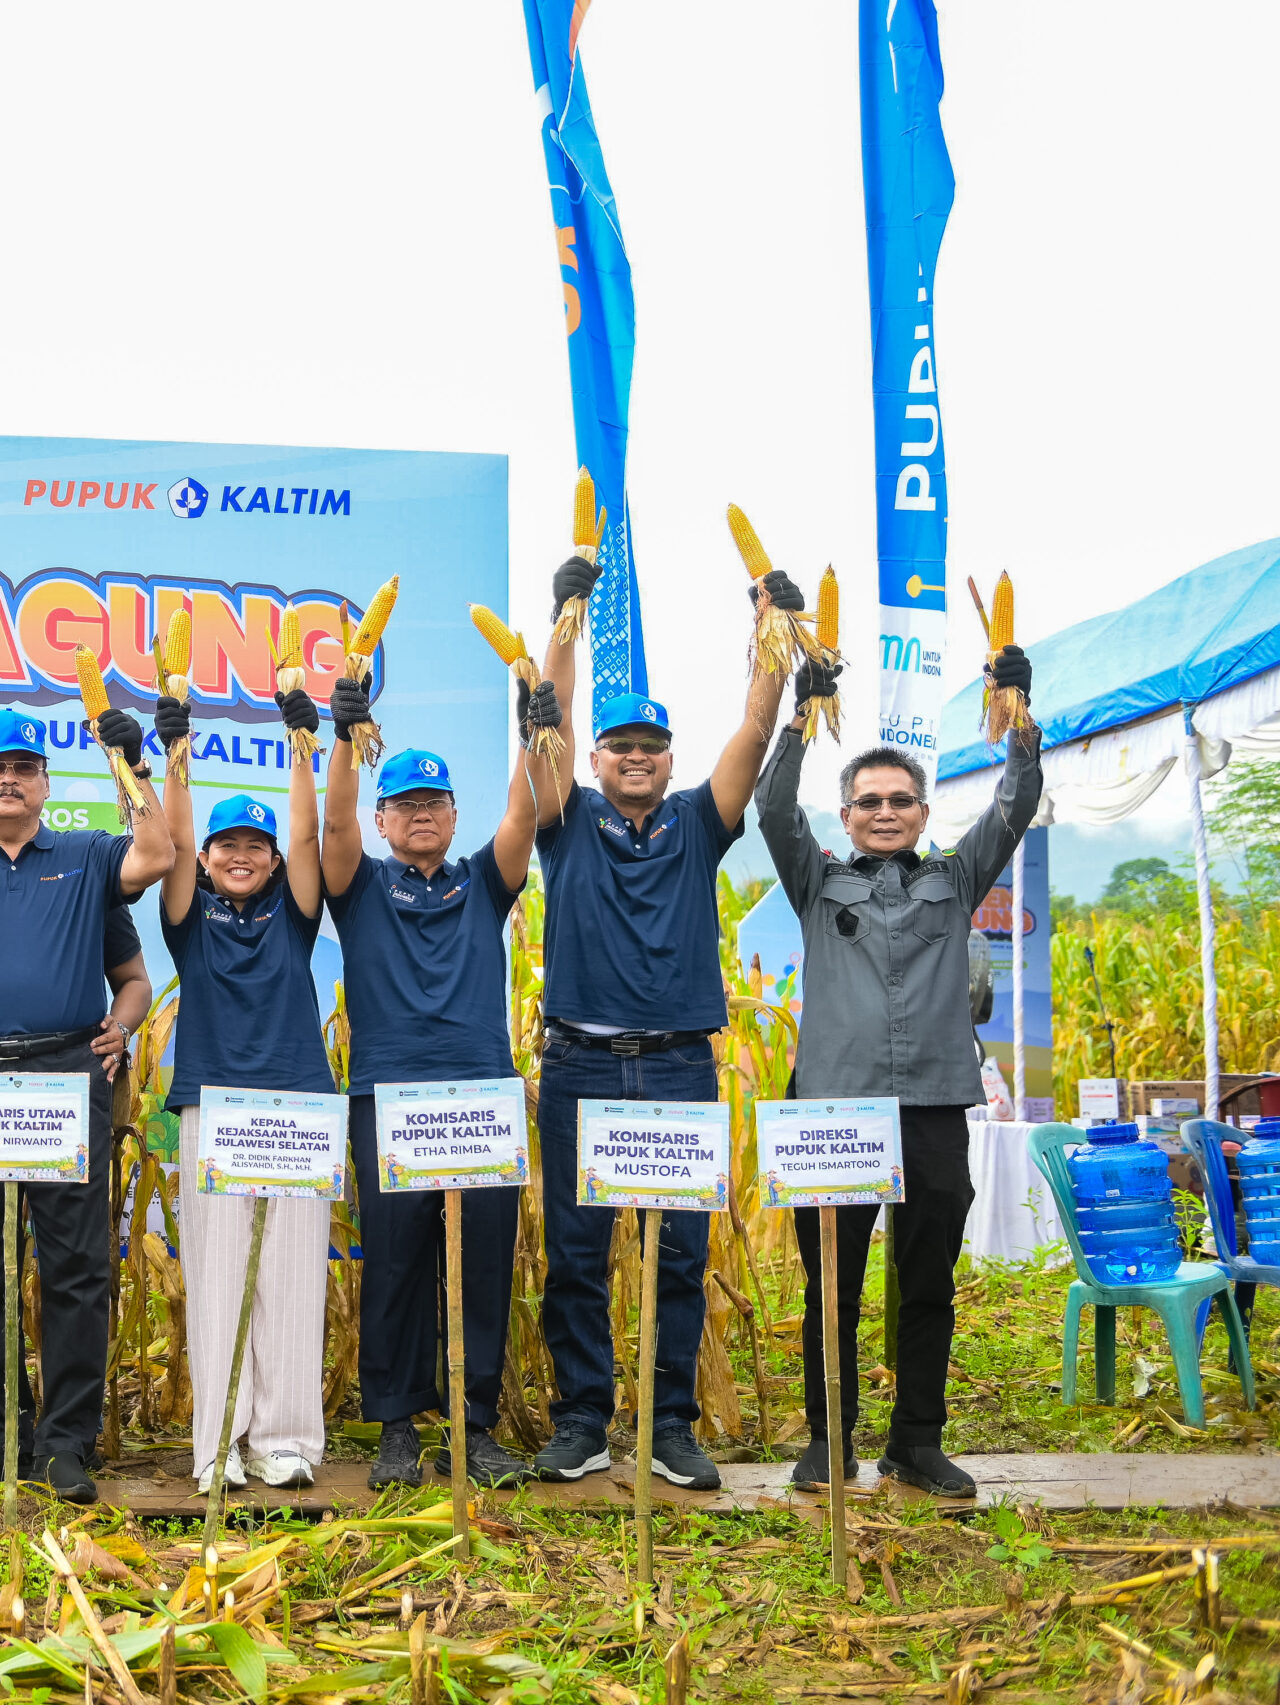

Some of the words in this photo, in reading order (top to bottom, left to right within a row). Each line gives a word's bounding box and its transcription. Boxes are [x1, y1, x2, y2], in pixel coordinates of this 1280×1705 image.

[23, 479, 159, 510] PUPUK
[220, 485, 351, 516] KALTIM
[29, 1109, 76, 1118] UTAMA
[406, 1110, 495, 1125] KOMISARIS
[14, 1121, 62, 1131] KALTIM
[251, 1118, 296, 1128] KEPALA
[218, 1128, 287, 1138] KEJAKSAAN
[291, 1131, 329, 1140] TINGGI
[392, 1128, 447, 1141] PUPUK
[453, 1125, 511, 1138] KALTIM
[609, 1130, 699, 1145] KOMISARIS
[800, 1129, 857, 1140] DIREKSI
[4, 1138, 62, 1146] NIRWANTO
[215, 1138, 274, 1149] SULAWESI
[278, 1141, 330, 1151] SELATAN
[414, 1147, 447, 1157] ETHA
[451, 1144, 491, 1155] RIMBA
[594, 1145, 650, 1158] PUPUK
[655, 1148, 714, 1161] KALTIM
[775, 1144, 826, 1156] PUPUK
[830, 1142, 884, 1154] KALTIM
[231, 1162, 274, 1170] ALISYAHDI,
[615, 1163, 691, 1177] MUSTOFA
[781, 1162, 815, 1171] TEGUH
[819, 1160, 880, 1170] ISMARTONO
